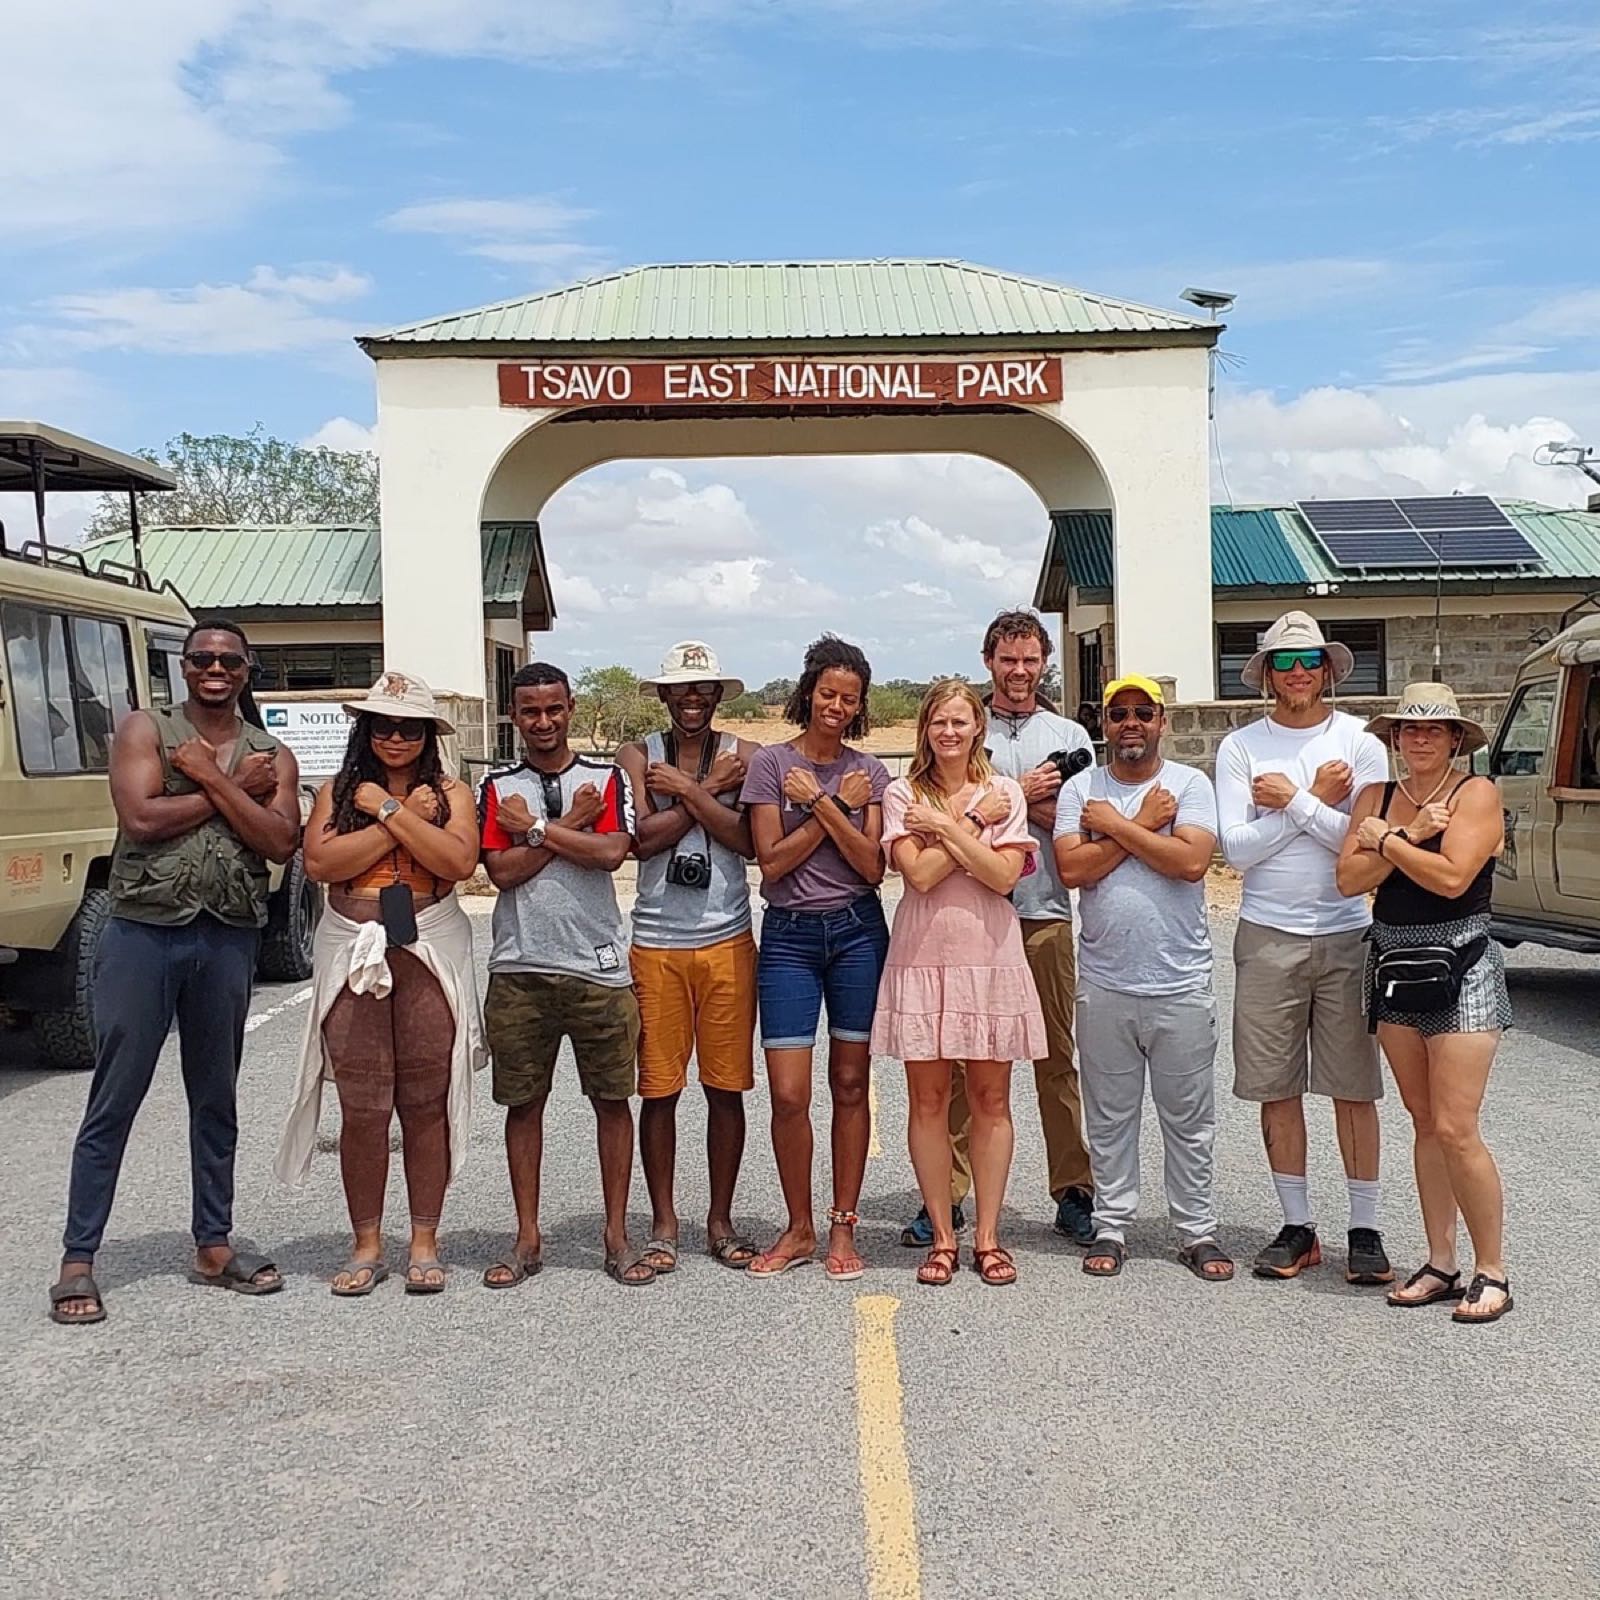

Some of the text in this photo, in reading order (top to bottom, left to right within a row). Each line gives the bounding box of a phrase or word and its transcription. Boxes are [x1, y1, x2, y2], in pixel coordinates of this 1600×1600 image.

[520, 360, 1050, 400] TSAVO EAST NATIONAL PARK
